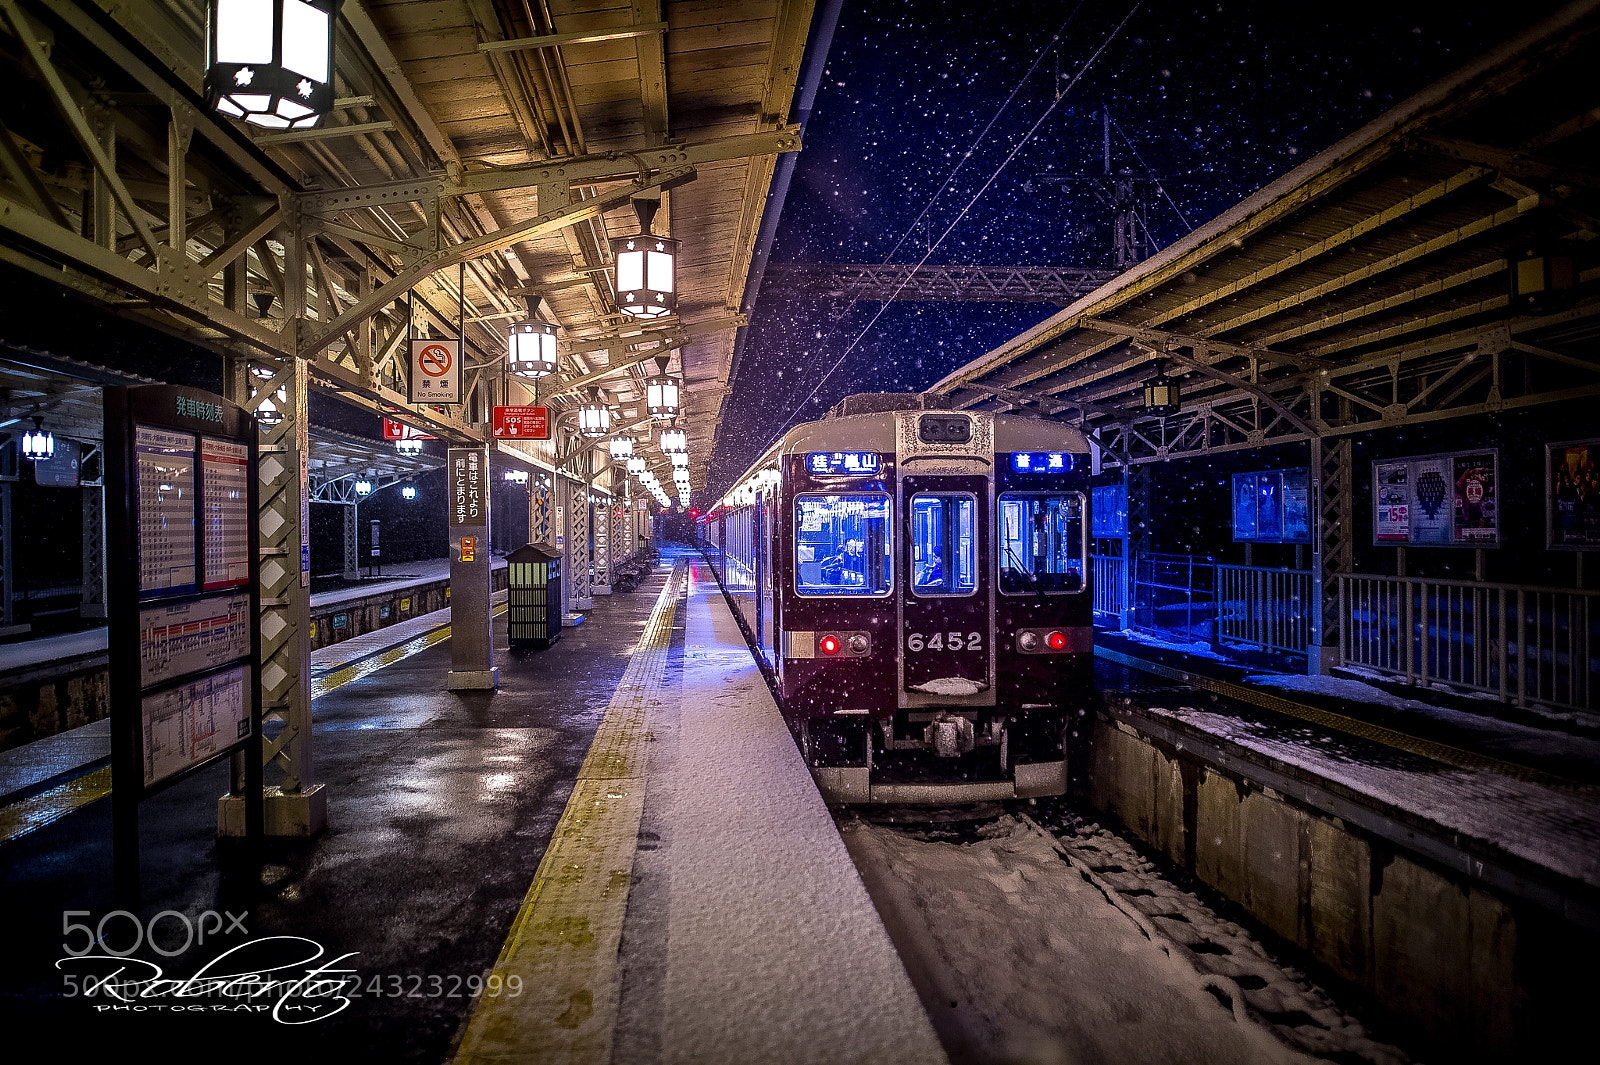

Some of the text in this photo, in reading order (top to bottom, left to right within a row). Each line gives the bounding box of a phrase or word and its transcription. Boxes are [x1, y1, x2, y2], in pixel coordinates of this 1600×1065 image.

[422, 380, 449, 388] 禁煙
[176, 395, 223, 423] 発車時刻表
[455, 458, 467, 523] 前にとまります
[468, 452, 479, 517] 電車はこれより
[908, 632, 982, 652] 6452
